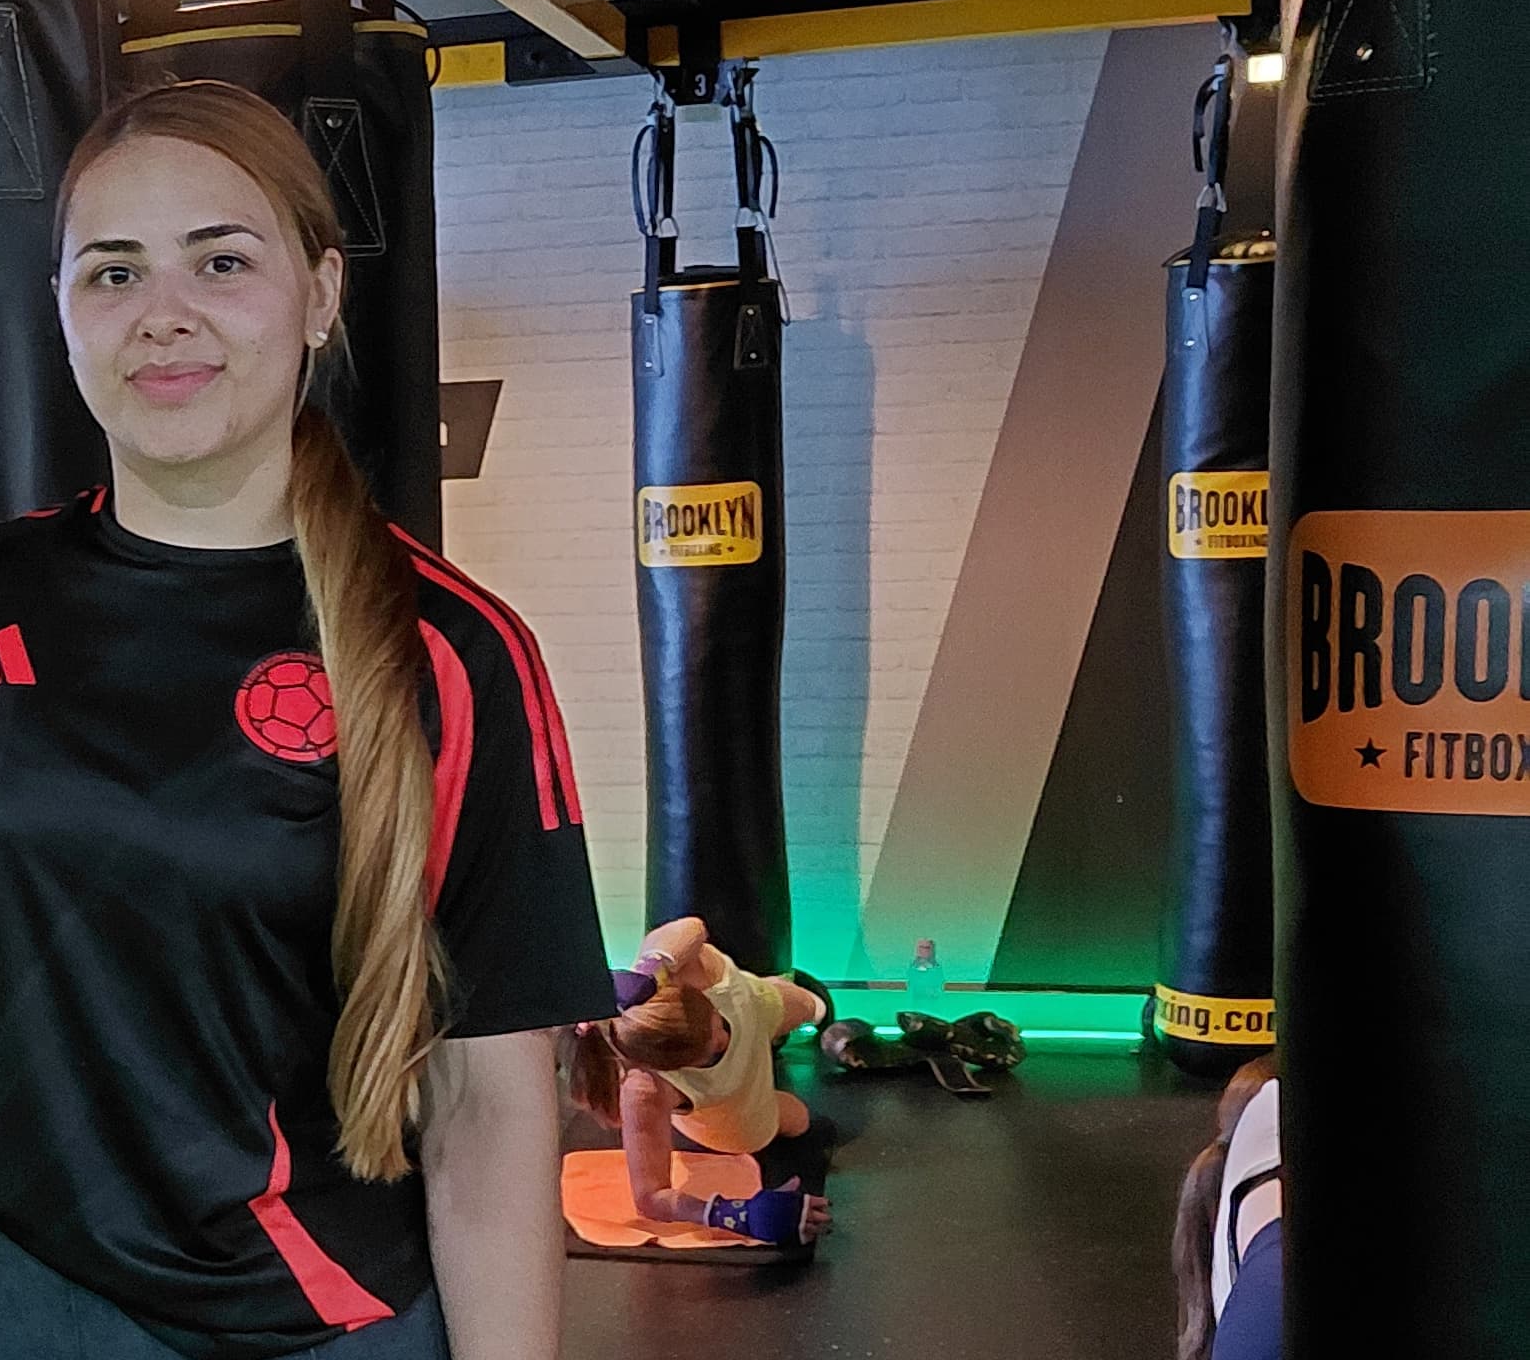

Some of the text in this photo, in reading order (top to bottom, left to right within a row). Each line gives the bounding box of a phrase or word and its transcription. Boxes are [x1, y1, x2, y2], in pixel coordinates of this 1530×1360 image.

[693, 73, 708, 97] 3
[643, 491, 756, 544] BROOKLYN
[1302, 550, 1530, 724] BROO
